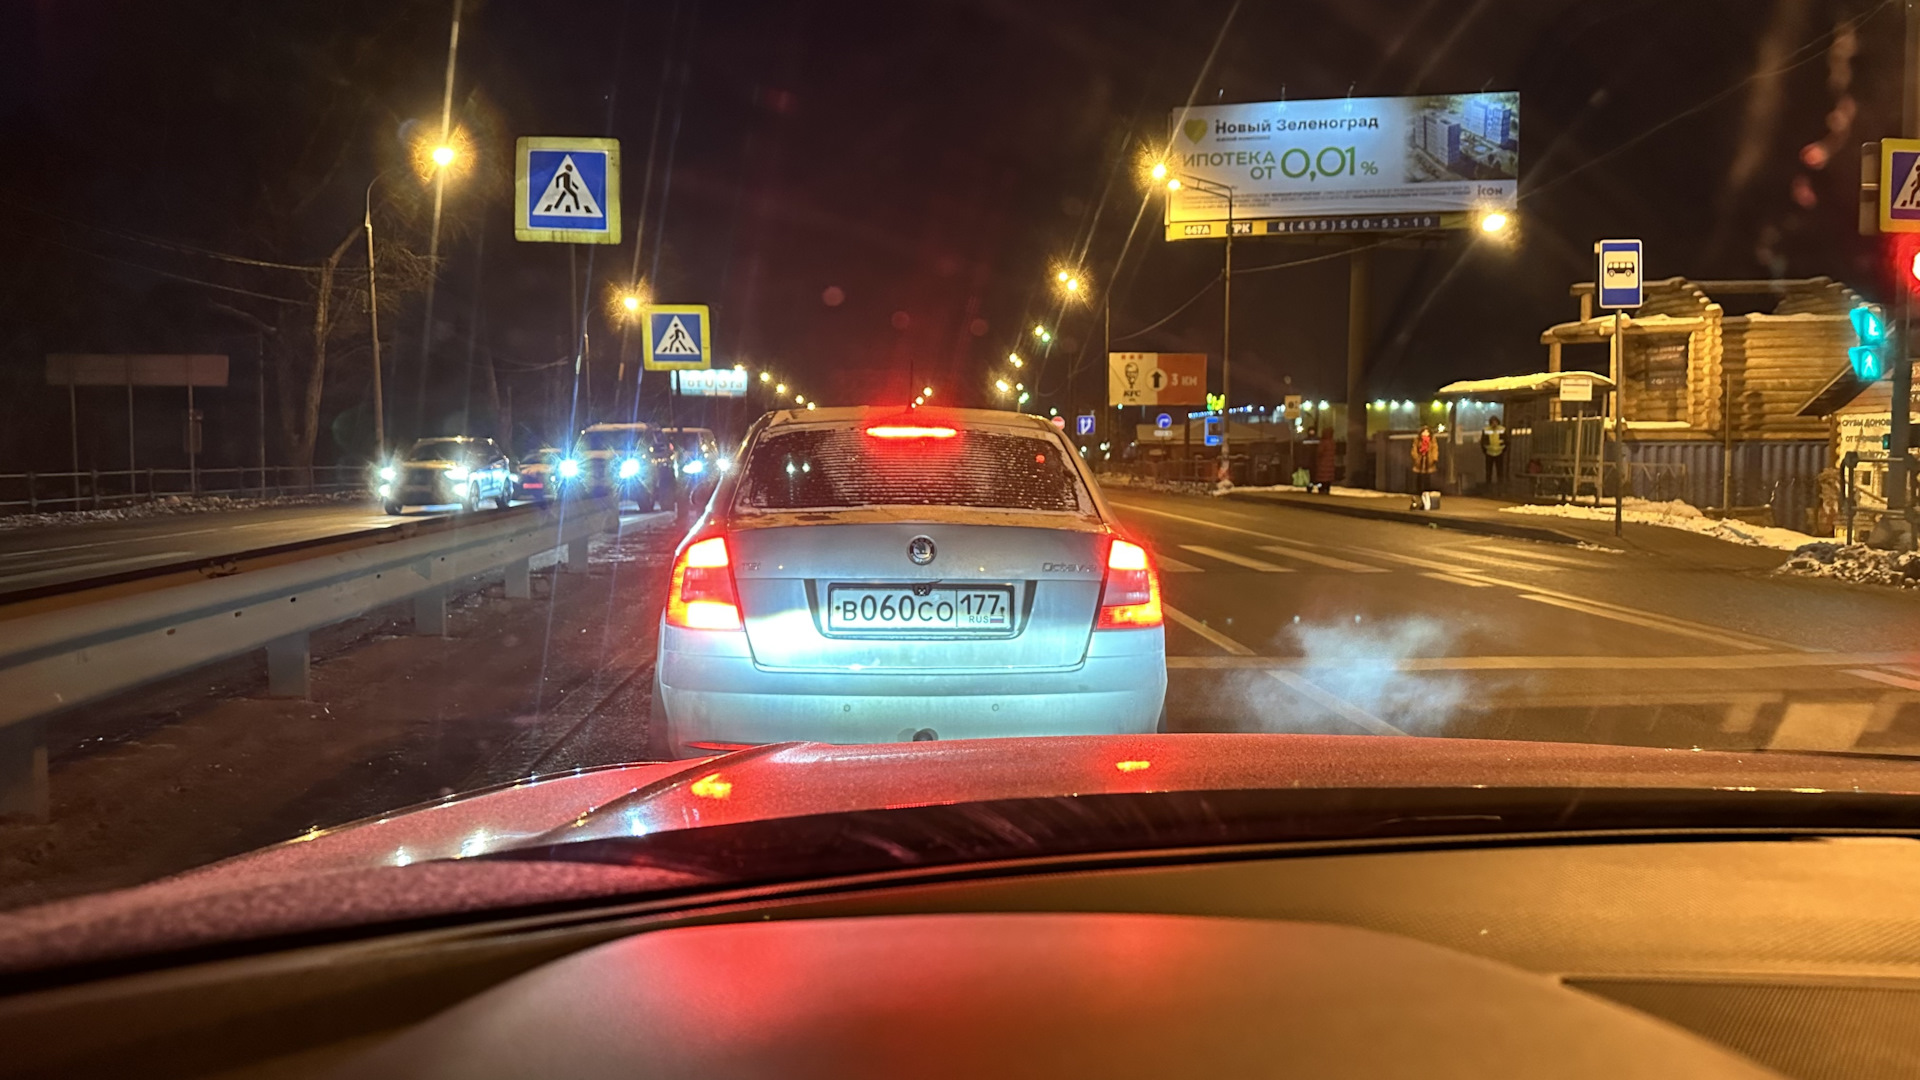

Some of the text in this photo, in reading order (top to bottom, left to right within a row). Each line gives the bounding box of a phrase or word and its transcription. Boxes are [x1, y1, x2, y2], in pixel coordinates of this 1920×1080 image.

[1215, 117, 1379, 134] Новый Зеленоград
[1183, 151, 1276, 167] ИПОТЕКА
[1250, 165, 1276, 180] ОТ
[1360, 161, 1379, 175] %
[1171, 373, 1179, 386] 3
[842, 594, 1001, 622] В060СО 177
[968, 615, 989, 624] RUS
